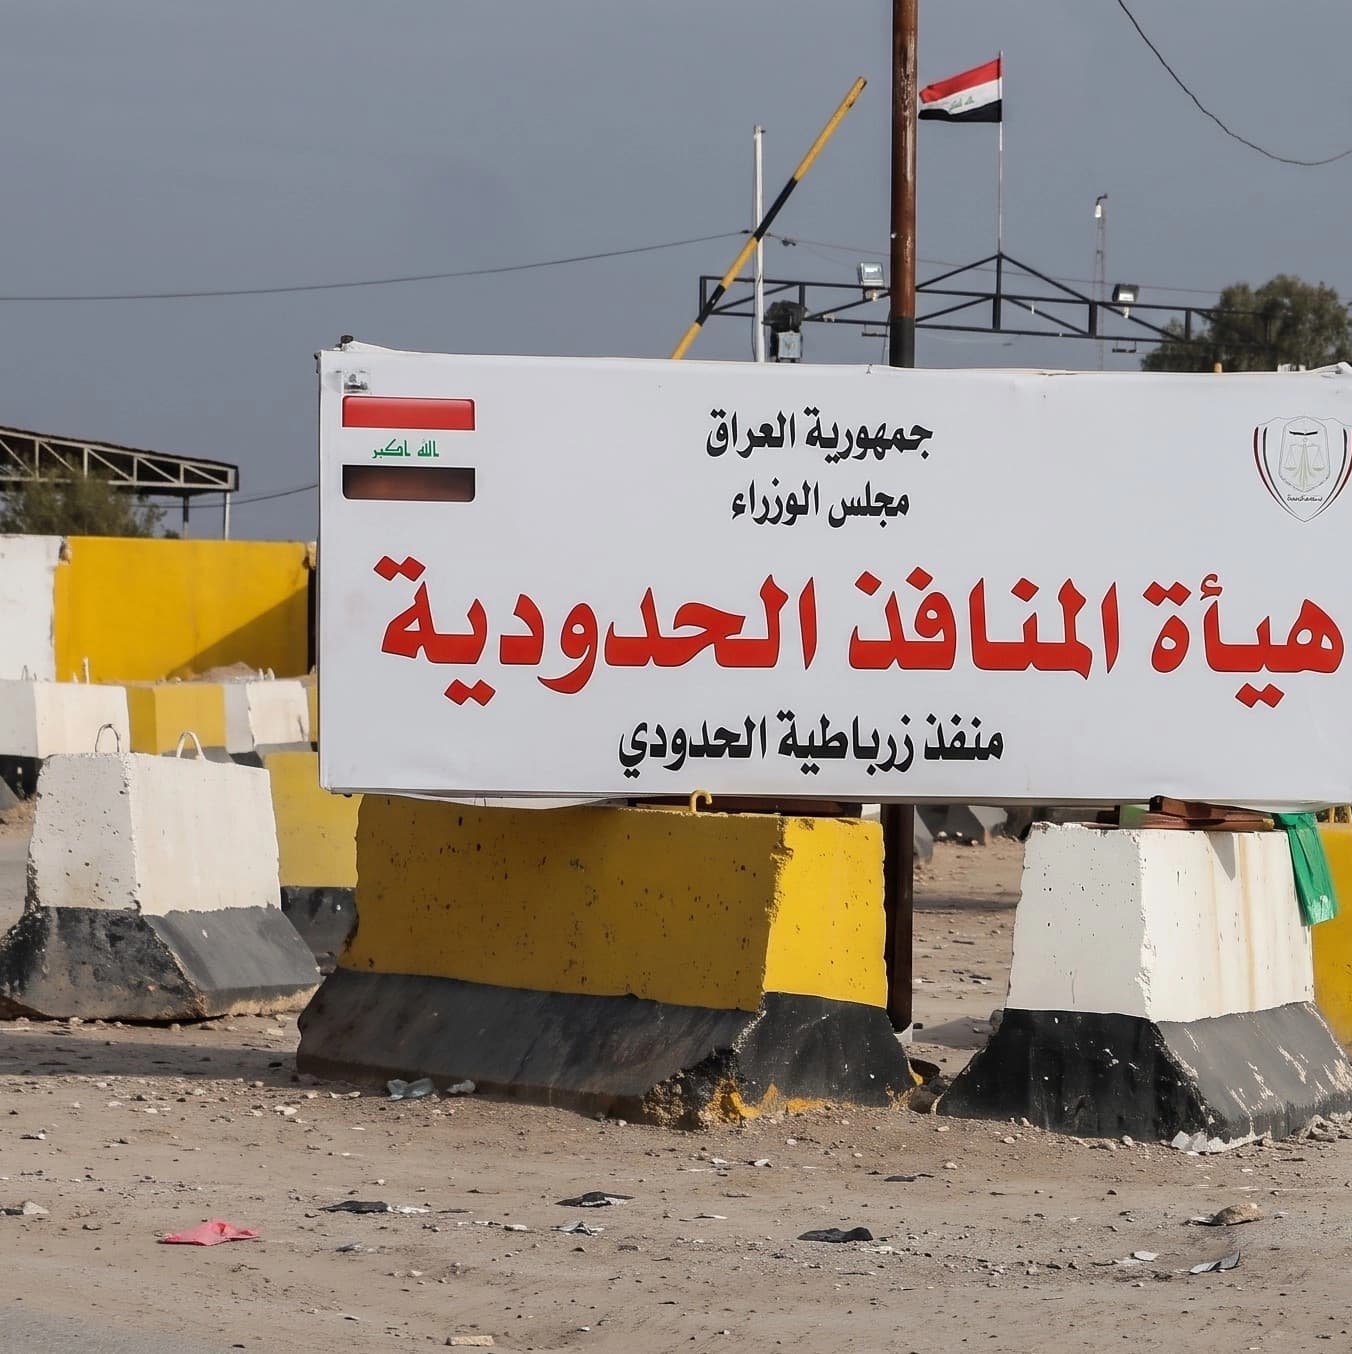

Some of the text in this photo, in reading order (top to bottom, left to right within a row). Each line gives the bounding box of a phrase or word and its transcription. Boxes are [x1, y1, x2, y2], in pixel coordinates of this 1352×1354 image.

[706, 406, 934, 464] جمهورية العراق
[731, 477, 911, 529] مجلس الوزراء
[374, 556, 1345, 708] هيأة المنافذ الحدودية
[618, 709, 1004, 779] منفذ زرباطية الحدودي
